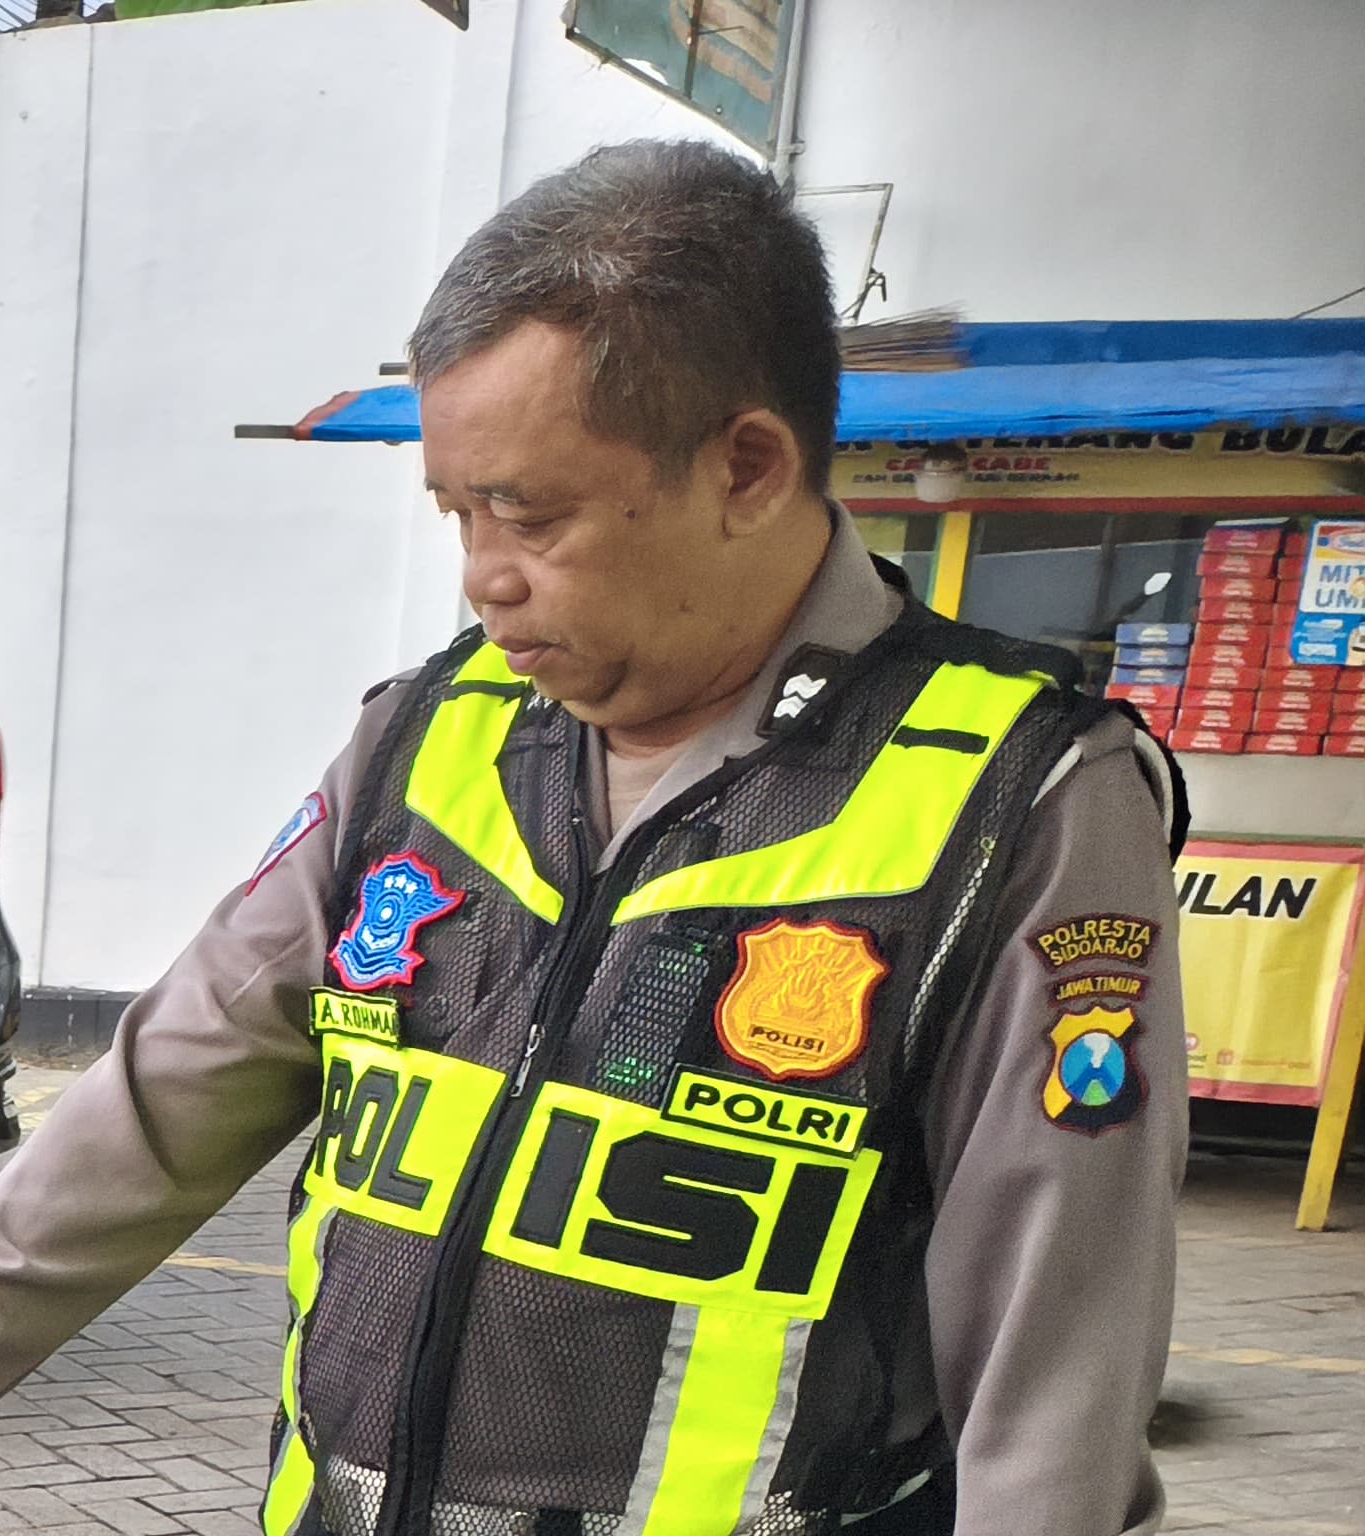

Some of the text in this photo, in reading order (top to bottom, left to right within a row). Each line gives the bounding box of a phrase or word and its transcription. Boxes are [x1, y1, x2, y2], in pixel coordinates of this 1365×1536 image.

[1038, 919, 1151, 953] POLRESTA
[1050, 938, 1143, 966] SIDOARJO
[1056, 976, 1142, 1000] JAWA TIMUR
[751, 1026, 825, 1053] POLISI
[684, 1083, 851, 1142] POLRI
